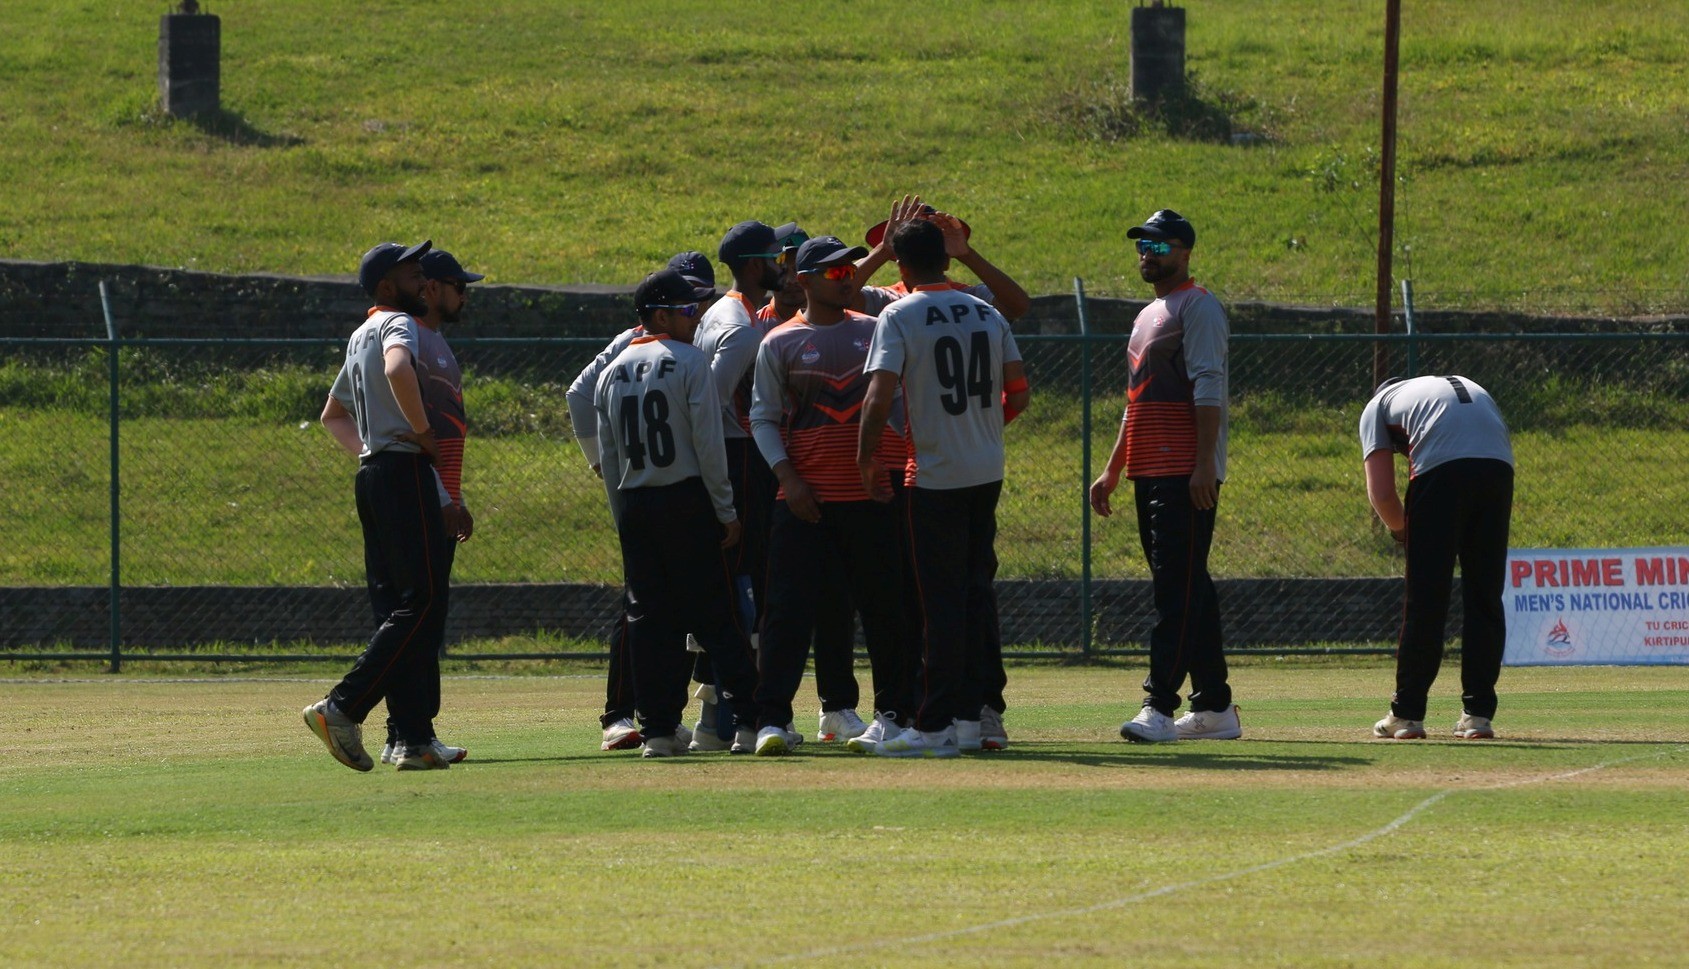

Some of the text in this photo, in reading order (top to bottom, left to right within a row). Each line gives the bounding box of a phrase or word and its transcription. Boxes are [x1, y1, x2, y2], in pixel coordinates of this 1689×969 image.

[925, 304, 991, 326] APF
[348, 327, 377, 357] PF
[612, 358, 677, 384] APF
[934, 331, 993, 416] 94
[620, 389, 676, 471] 48
[1510, 558, 1624, 588] PRIME
[1515, 591, 1689, 612] MEN'S NATIONAL CRI
[1645, 621, 1660, 631] TU
[1644, 636, 1689, 647] KIRTIPU
